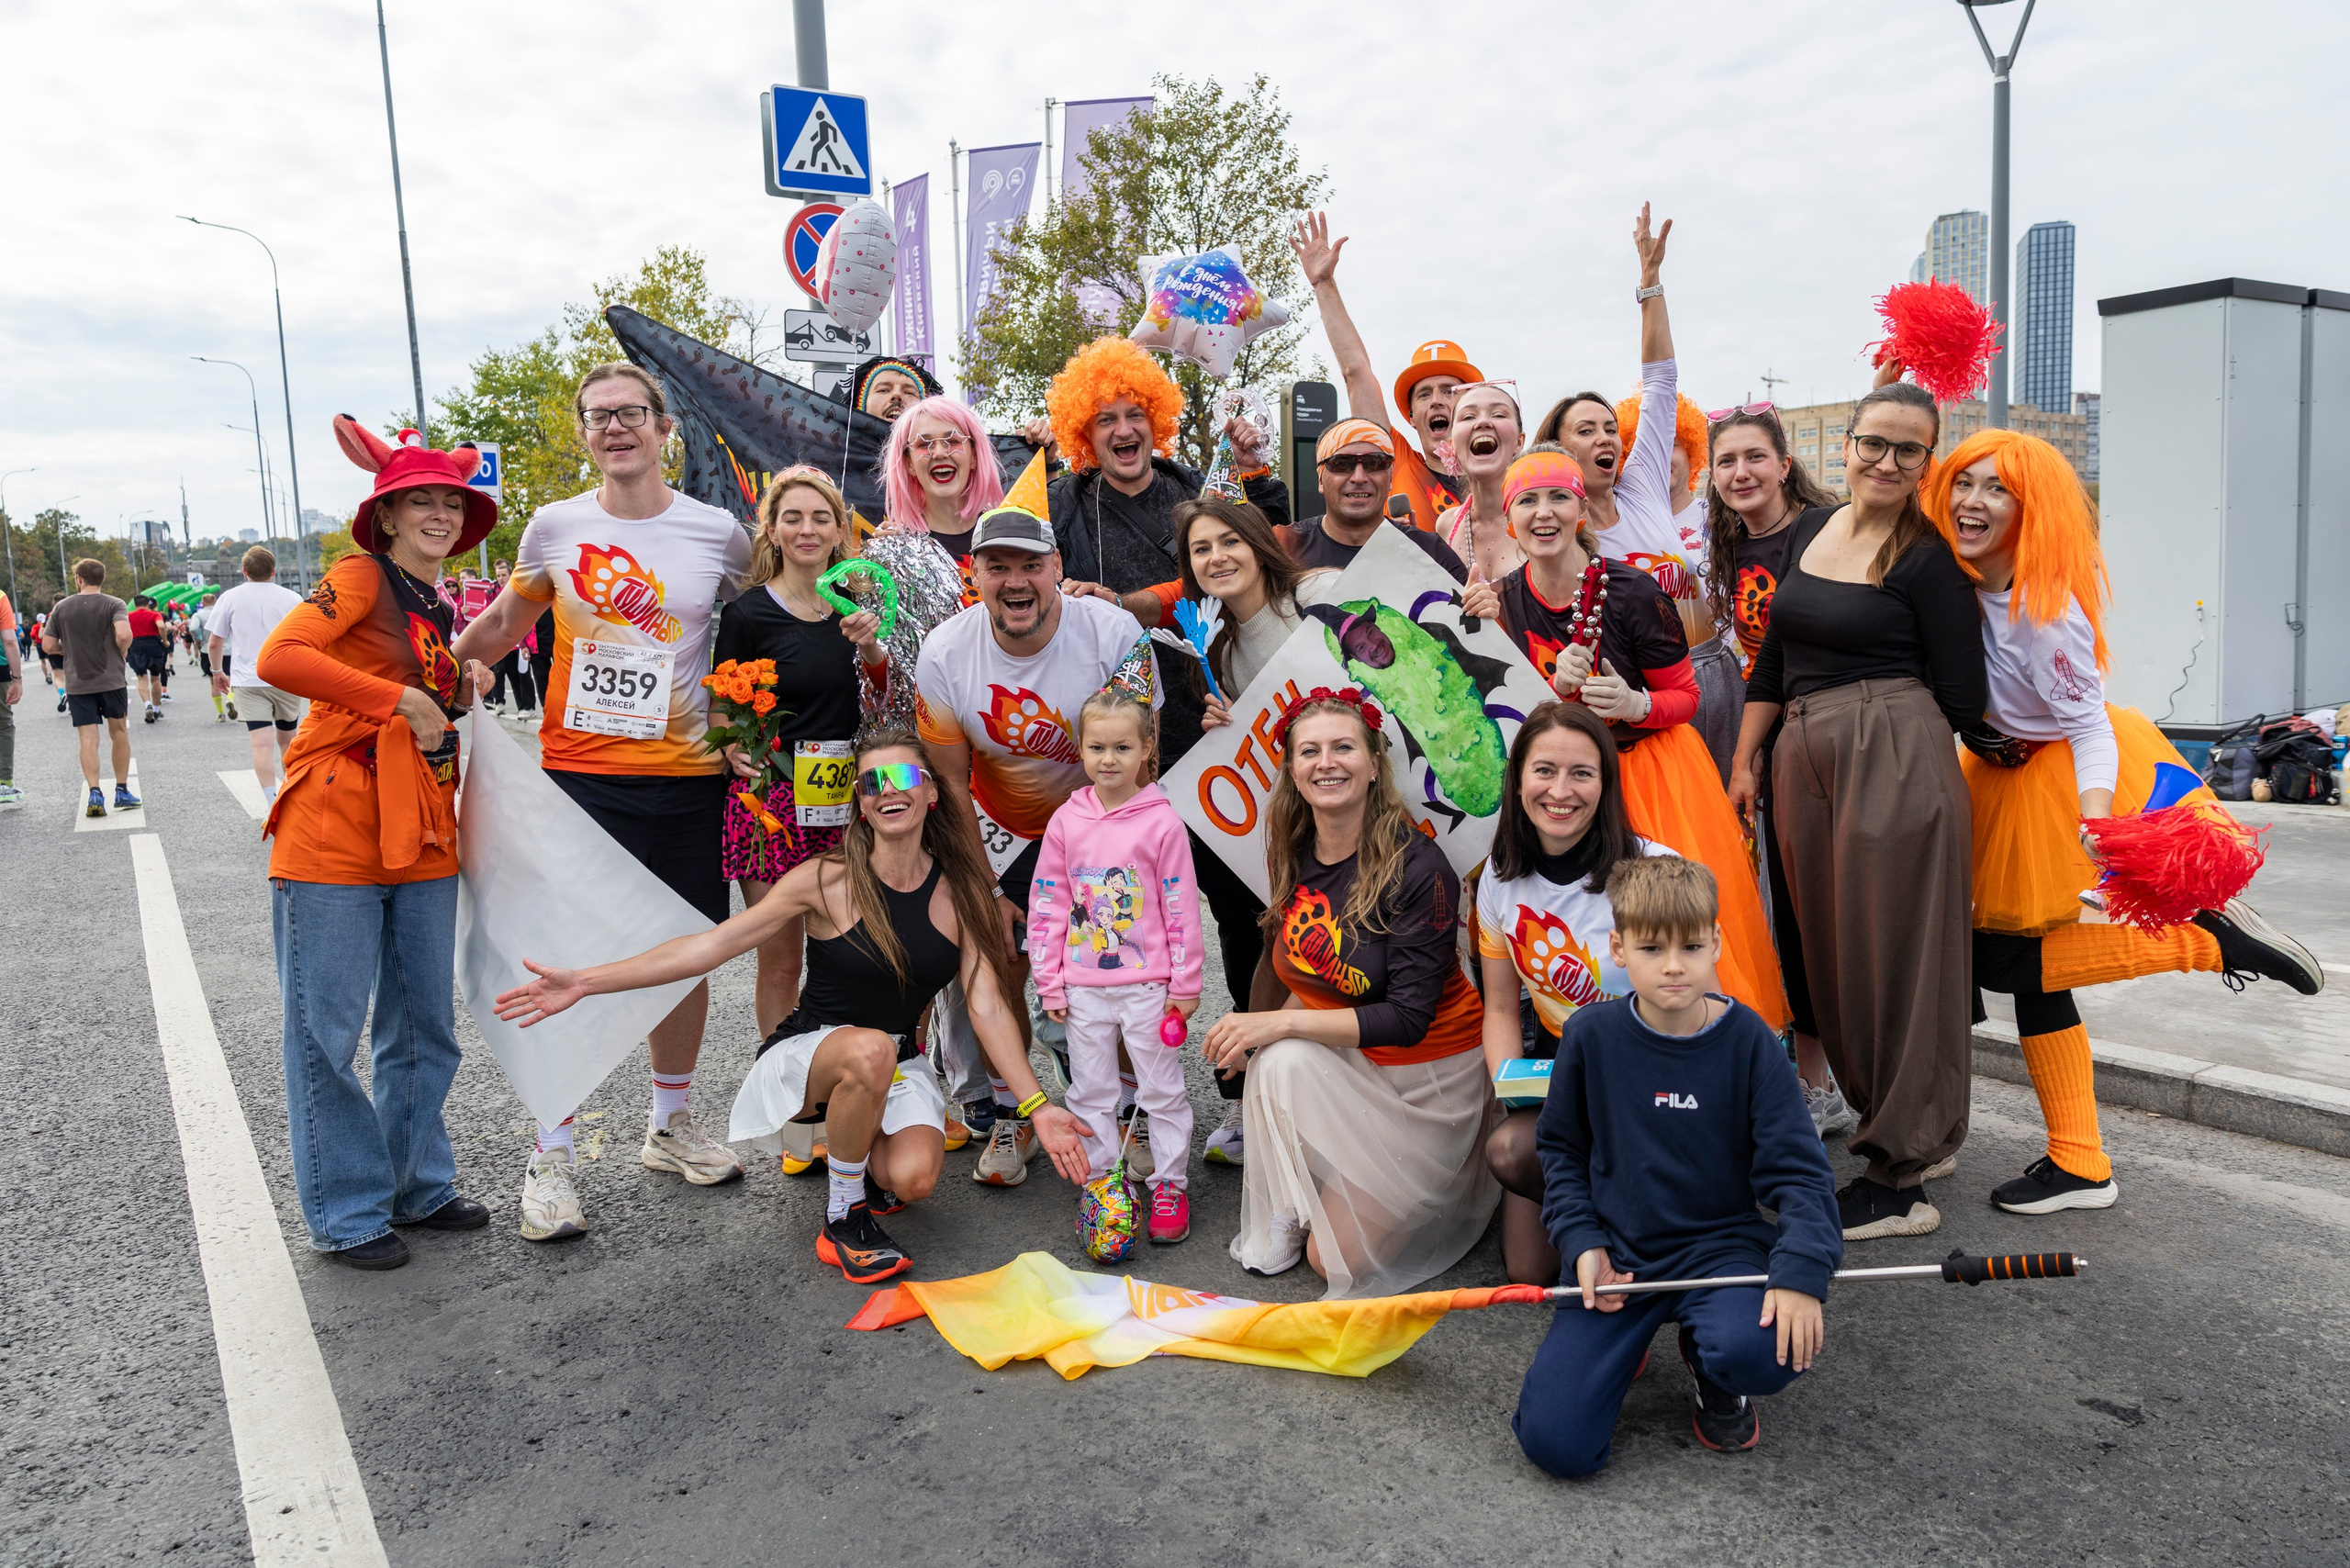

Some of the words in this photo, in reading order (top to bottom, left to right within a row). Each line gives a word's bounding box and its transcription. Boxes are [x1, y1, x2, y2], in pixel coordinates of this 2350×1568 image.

[1162, 274, 1246, 316] рождения!
[581, 664, 657, 700] 3359
[596, 698, 635, 711] АЛЕКСЕЙ
[573, 711, 585, 727] E
[804, 808, 813, 823] F
[1654, 1092, 1698, 1110] FILA
